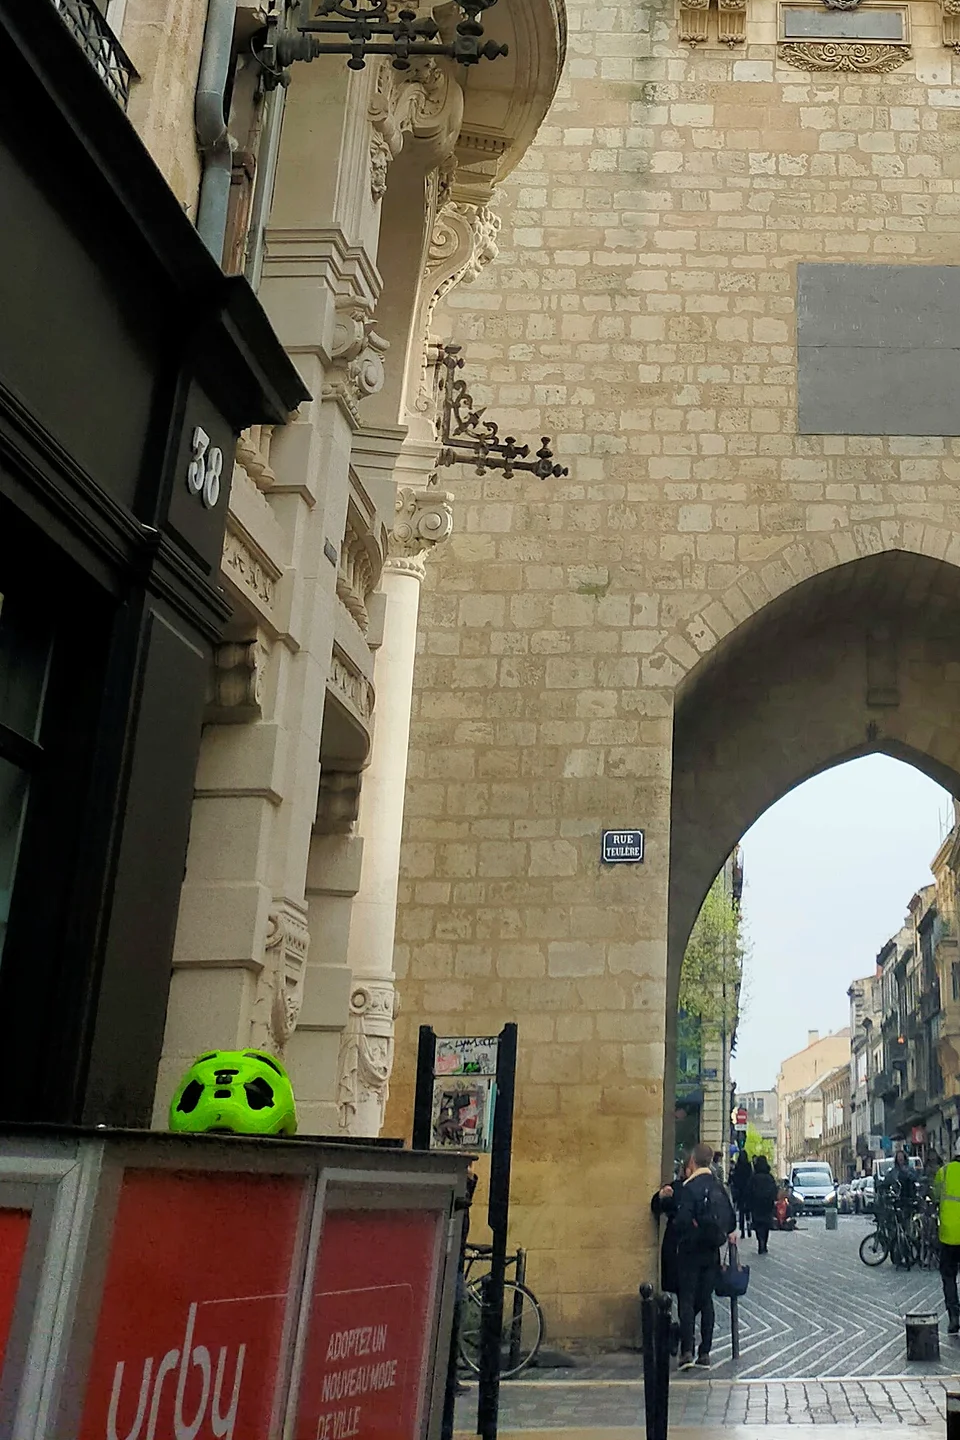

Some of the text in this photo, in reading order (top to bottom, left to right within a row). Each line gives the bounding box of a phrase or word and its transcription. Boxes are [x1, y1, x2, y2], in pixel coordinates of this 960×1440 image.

[187, 426, 223, 509] 38
[613, 834, 634, 844] RUE
[326, 1324, 388, 1362] ADOPTEZ UN
[106, 1302, 246, 1440] urby
[321, 1360, 398, 1403] NOUVEAU MODE
[316, 1406, 362, 1440] DE VILLE
